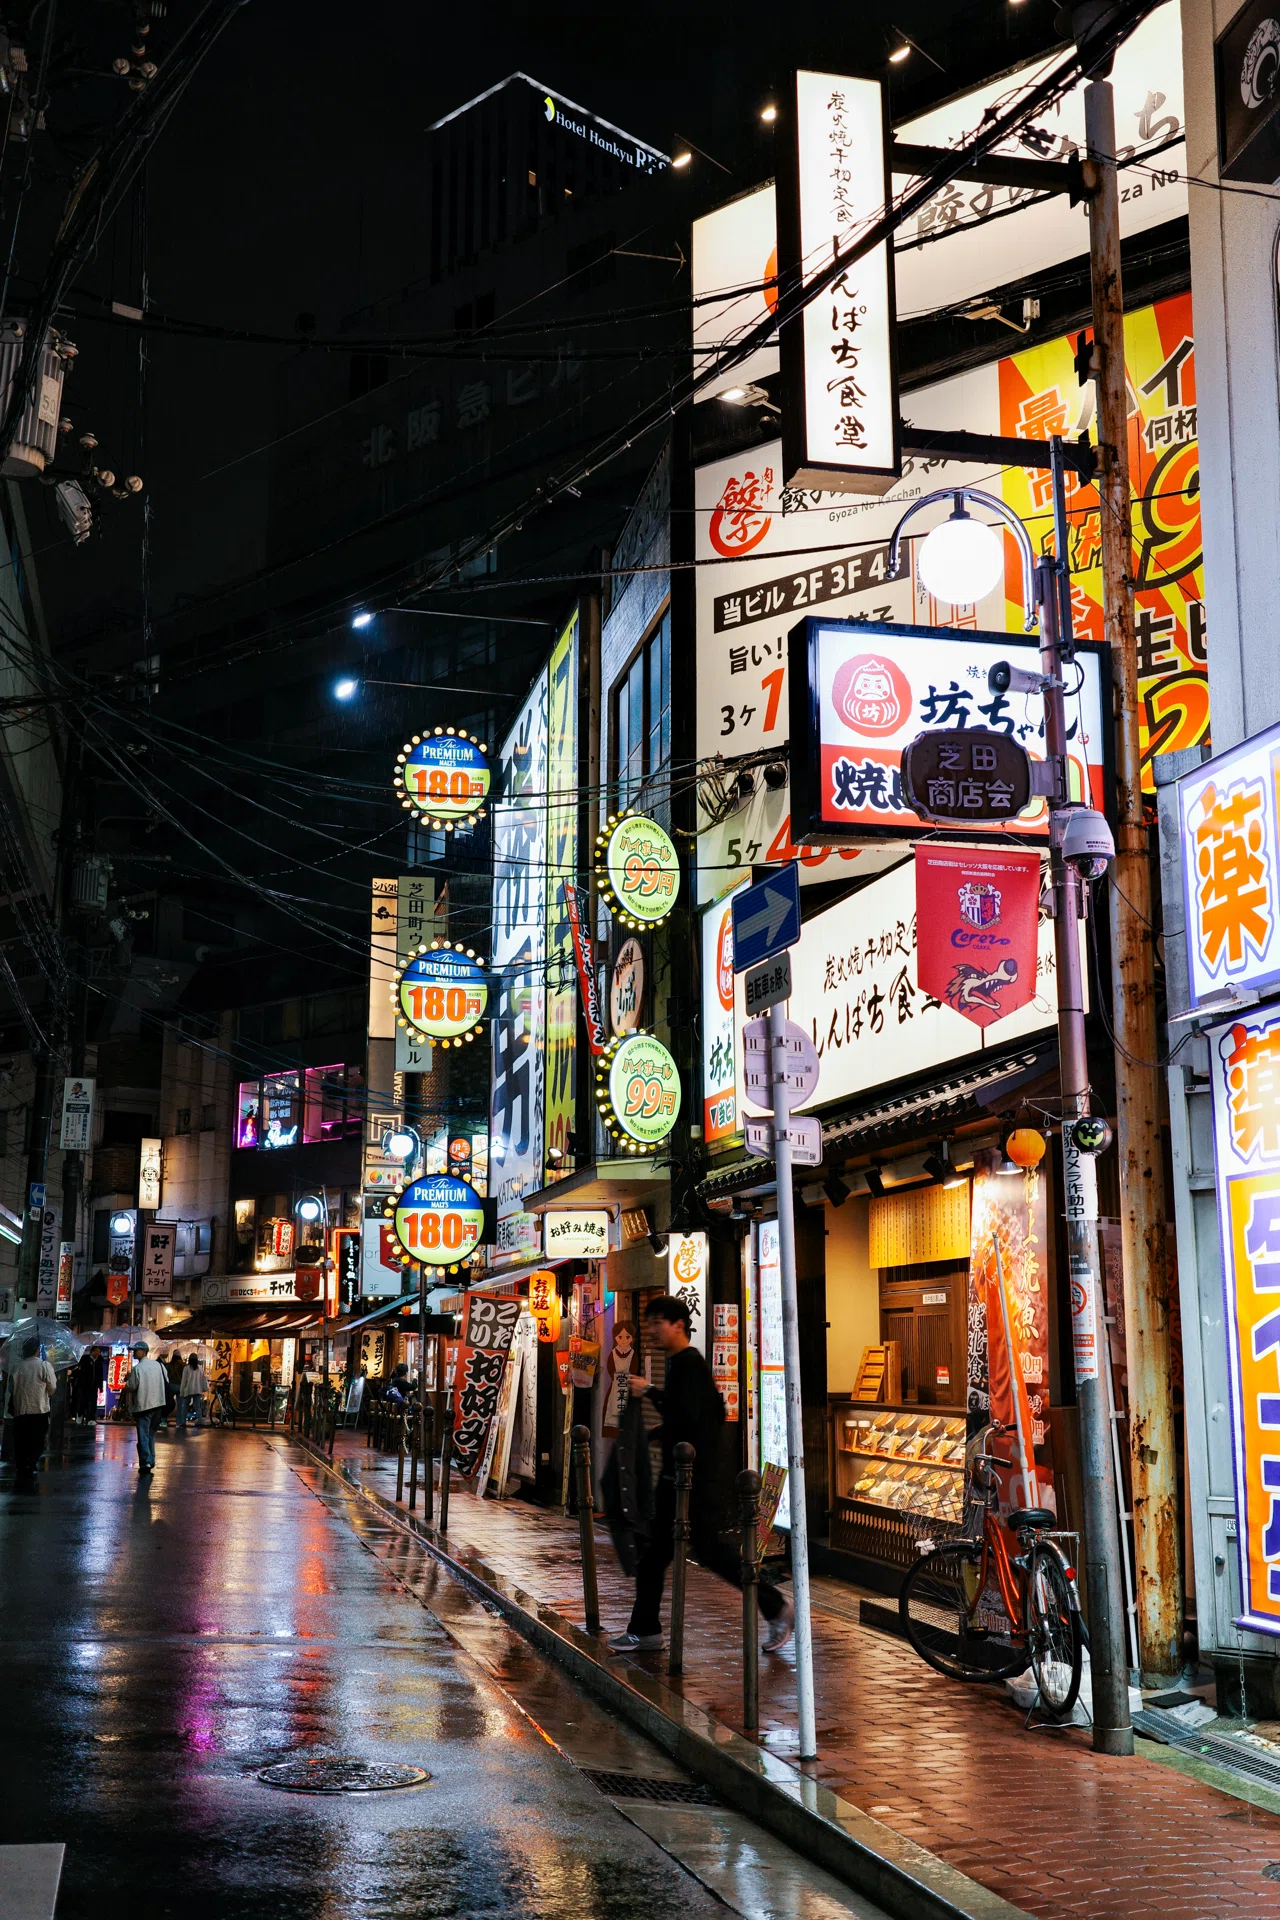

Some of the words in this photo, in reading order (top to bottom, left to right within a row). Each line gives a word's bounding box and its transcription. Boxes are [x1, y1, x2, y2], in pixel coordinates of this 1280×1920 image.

[556, 110, 587, 139] Hotel
[590, 129, 634, 165] Hankyu
[1150, 167, 1181, 192] No
[828, 506, 858, 522] Gyoza
[861, 501, 875, 513] No
[878, 485, 921, 507] Kacchan
[723, 590, 786, 626] 当ビル
[792, 570, 823, 606] 2F
[831, 562, 862, 596] 3F
[422, 745, 474, 761] PREMIUM
[435, 737, 461, 749] The
[938, 742, 999, 772] 芝田
[412, 769, 485, 805] 180円
[926, 776, 1016, 809] 商店会
[619, 836, 671, 862] ハイボール
[622, 853, 676, 897] 99円
[951, 928, 1011, 948] Cerezo
[418, 961, 472, 978] PREMIUM
[432, 951, 462, 964] The
[746, 967, 790, 1006] 自転車を除く
[407, 986, 482, 1023] 180円
[622, 1057, 673, 1080] ハイボール
[624, 1075, 677, 1119] 99円
[427, 1177, 454, 1189] The
[1063, 1124, 1085, 1219] 防犯カメラ作動中
[414, 1187, 467, 1202] PREMIUM
[431, 1200, 449, 1209] MALT'S
[151, 1234, 170, 1249] 餃子
[403, 1212, 478, 1249] 180円
[550, 1220, 606, 1238] お好み焼き
[39, 1225, 55, 1296] くすり・処方せん
[154, 1253, 163, 1265] と
[582, 1246, 604, 1254] メロディ
[1017, 1165, 1041, 1340] 極上焼魚
[146, 1268, 170, 1276] スーパー
[148, 1277, 166, 1286] ドライ
[369, 1283, 379, 1292] 3F
[616, 1373, 628, 1413] 営業中
